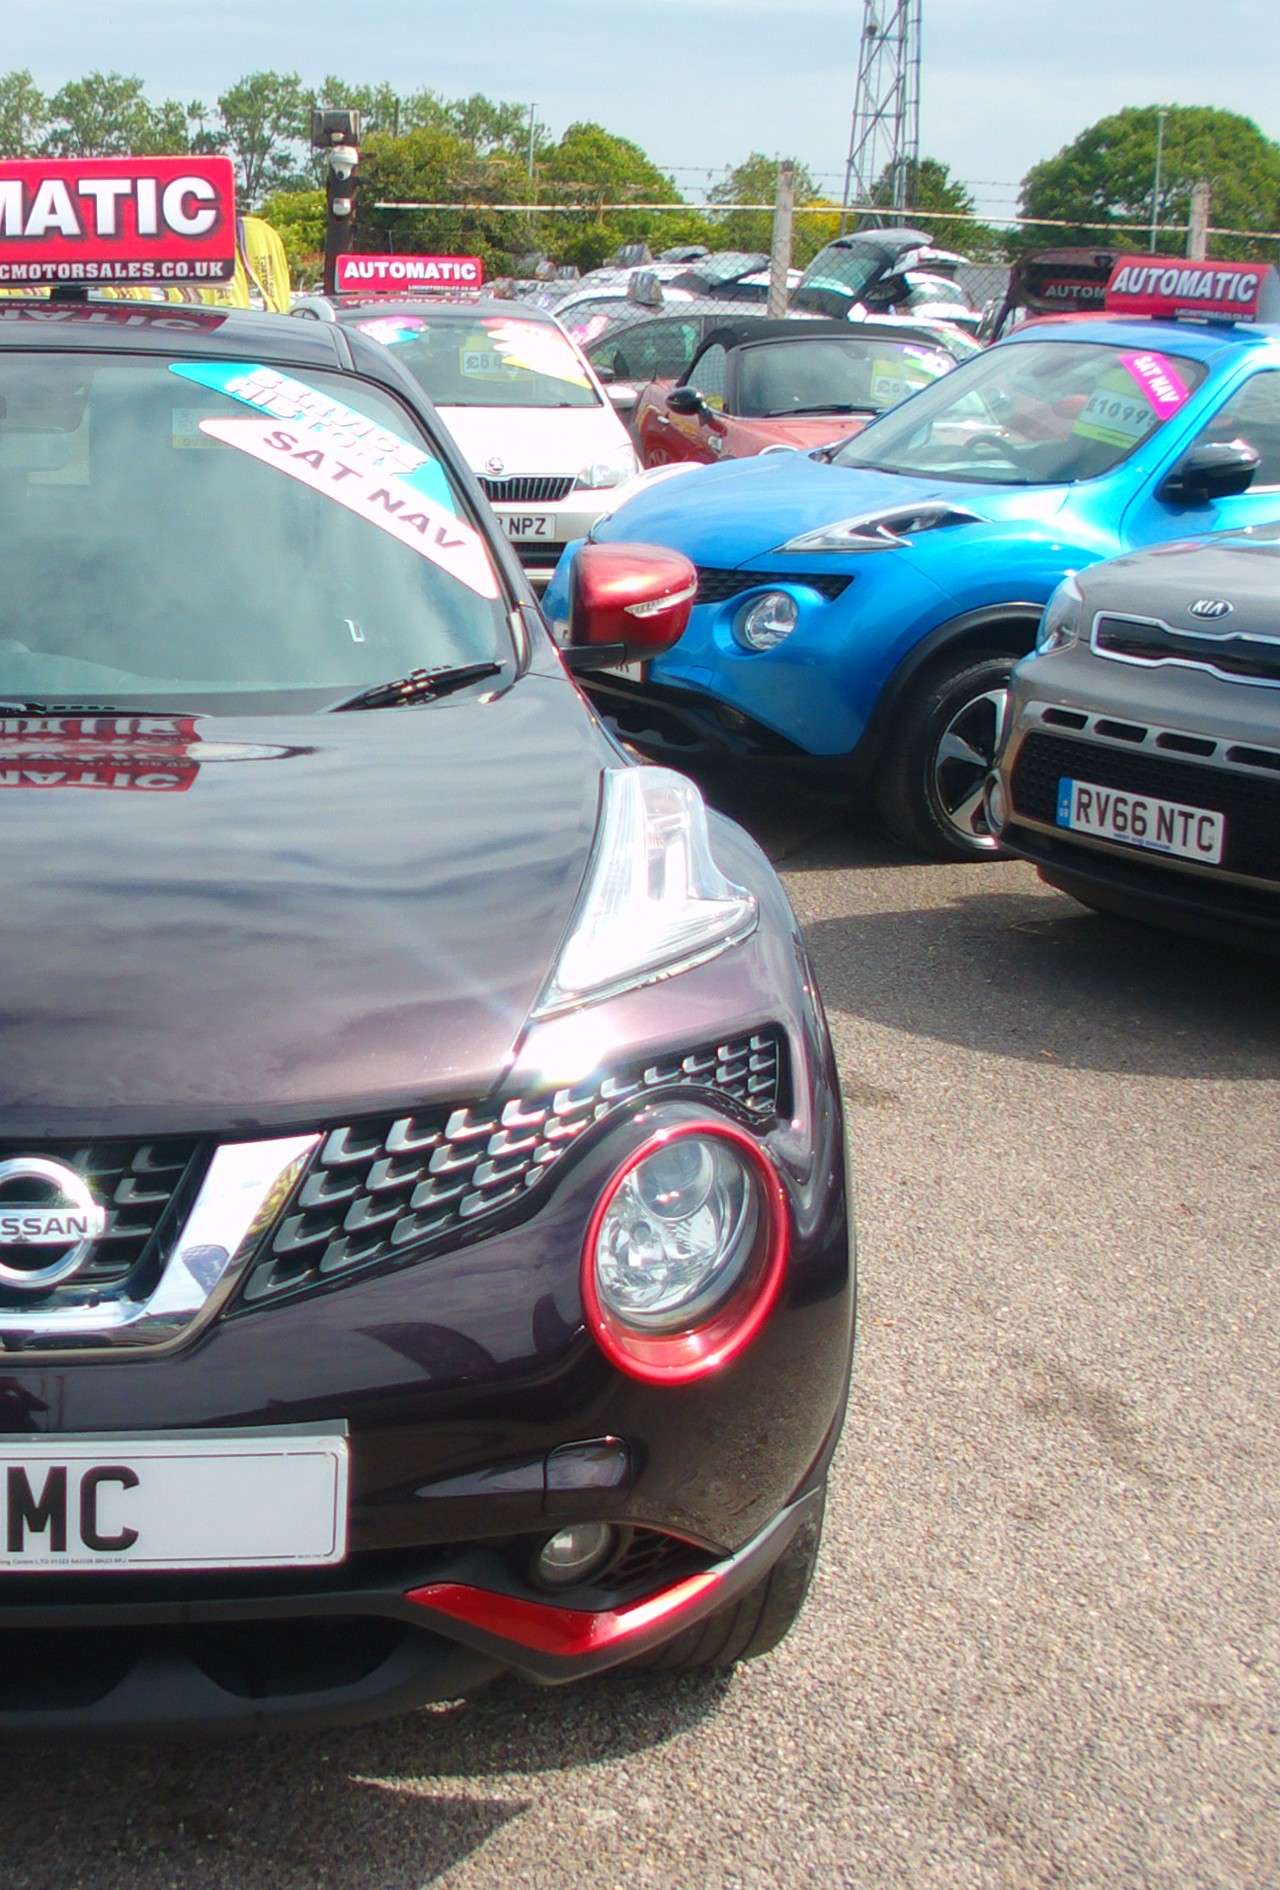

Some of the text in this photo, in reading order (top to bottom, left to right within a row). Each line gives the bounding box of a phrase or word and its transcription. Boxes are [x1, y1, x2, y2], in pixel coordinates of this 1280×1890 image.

[343, 261, 477, 280] AUTOMATIC
[1111, 266, 1258, 301] AUTOMATIC
[1132, 355, 1180, 403] SAT NAV
[263, 430, 467, 550] SAT NAV
[508, 517, 546, 536] NPZ
[1191, 599, 1225, 616] KIA
[1075, 786, 1216, 853] RV66 NTC
